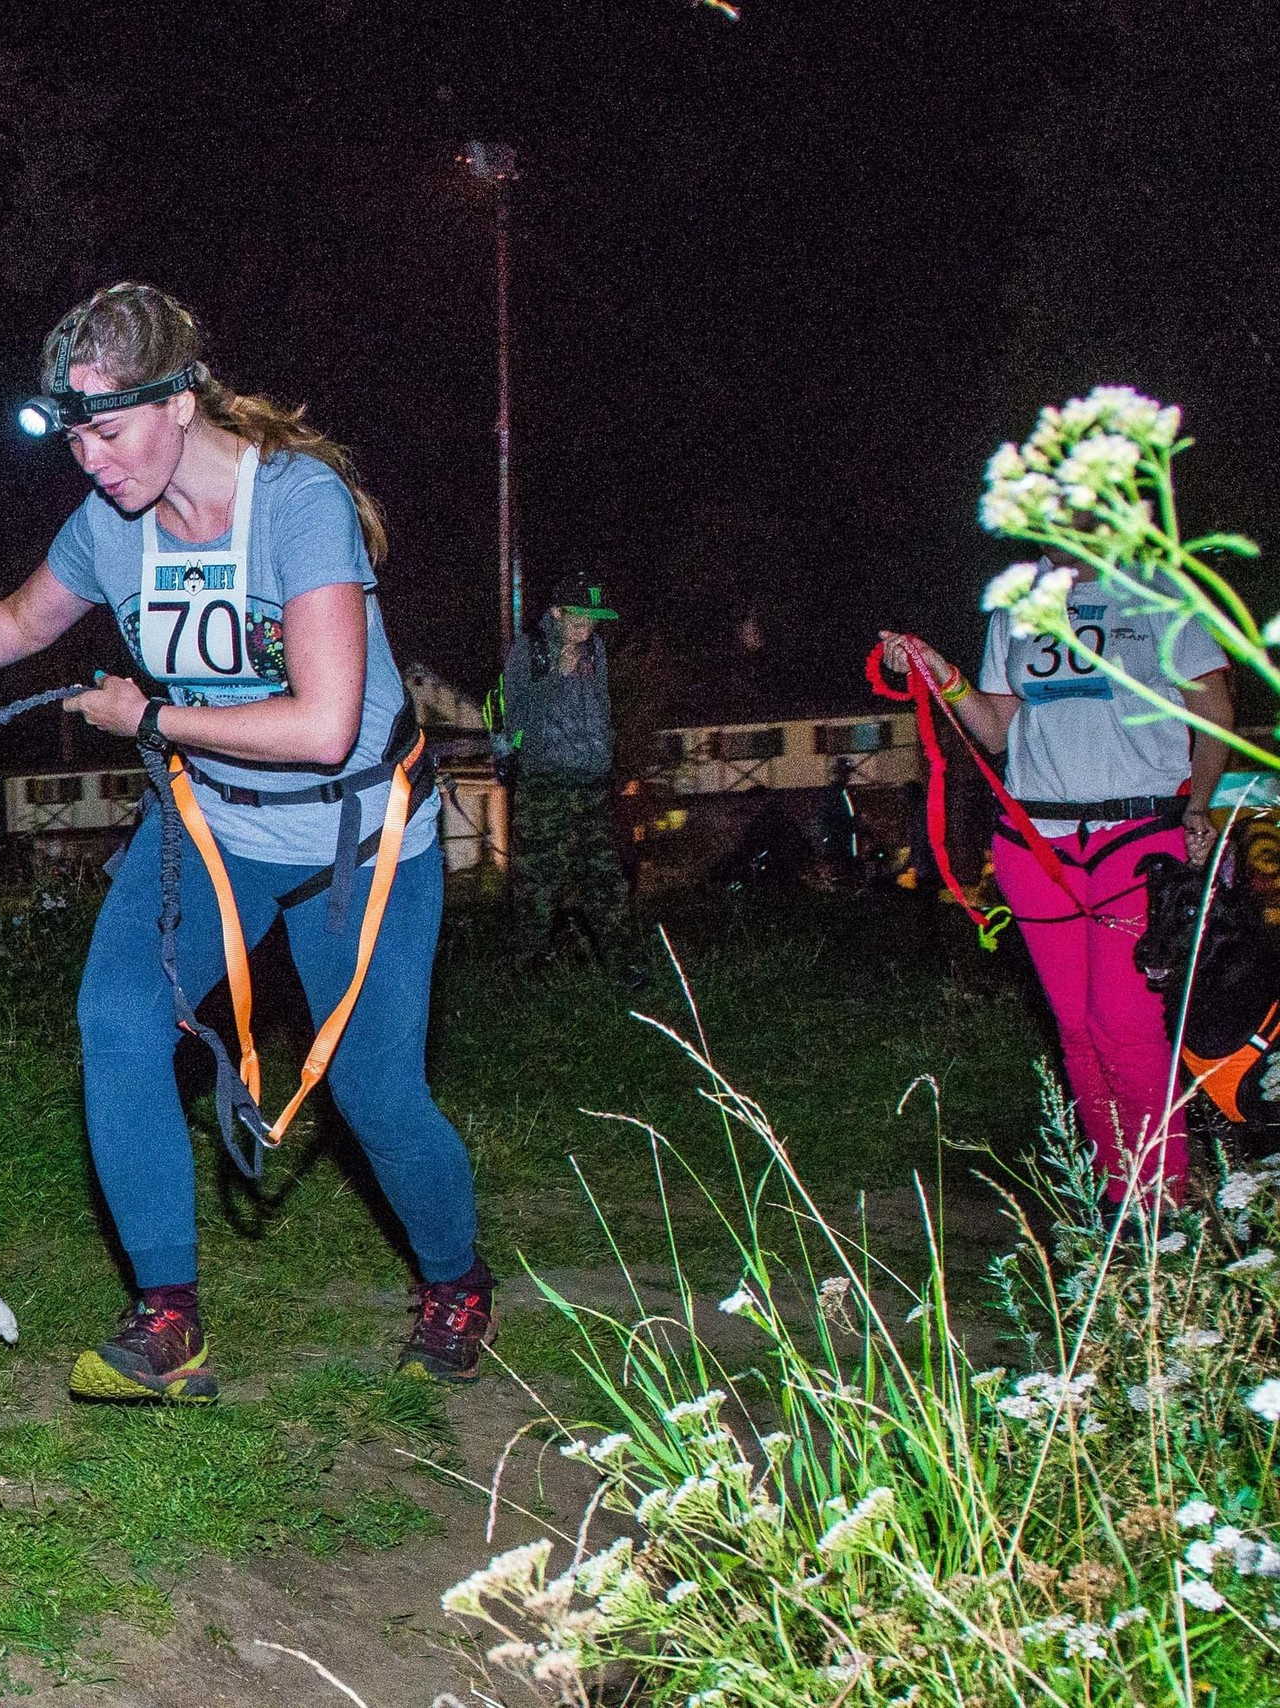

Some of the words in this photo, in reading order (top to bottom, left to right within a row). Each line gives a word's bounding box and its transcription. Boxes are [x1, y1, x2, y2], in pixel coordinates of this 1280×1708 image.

[53, 379, 64, 392] ED
[90, 392, 140, 411] HEADLIGHT
[154, 565, 187, 590] HEY
[202, 564, 237, 590] HEY
[147, 599, 243, 676] 70
[1026, 624, 1106, 678] 30
